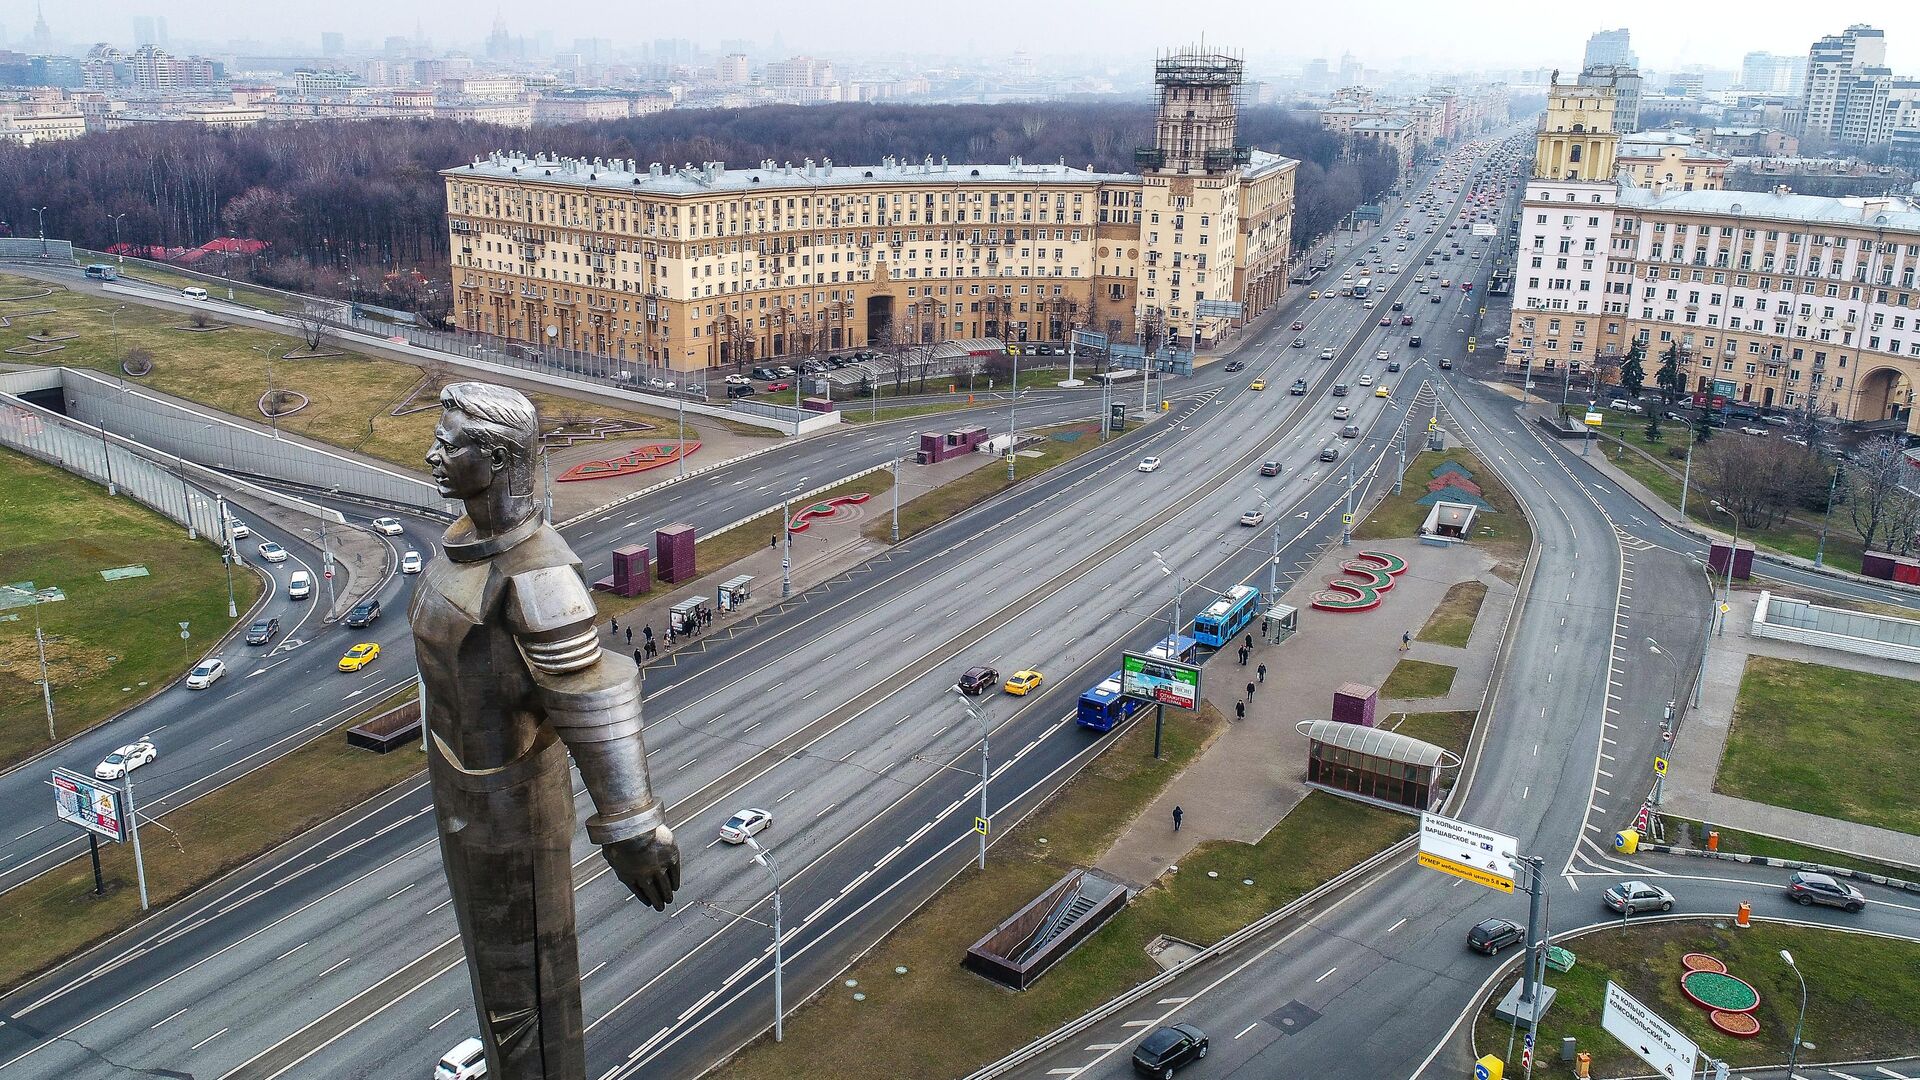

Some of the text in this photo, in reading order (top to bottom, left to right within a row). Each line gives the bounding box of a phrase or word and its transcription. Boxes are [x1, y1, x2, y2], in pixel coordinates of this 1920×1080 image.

[1425, 816, 1435, 824] 3-е
[1436, 820, 1463, 832] КОЛЬЦО
[1467, 830, 1494, 842] направо
[1425, 826, 1469, 845] ВАРШАВСКОЕ
[1420, 856, 1441, 866] РУМЕР
[1441, 863, 1473, 877] мебельный
[1473, 873, 1490, 883] центр
[1609, 999, 1663, 1043] КОМСОМОЛЬСКИЙ
[1663, 1041, 1677, 1053] пр-т
[1611, 989, 1620, 999] 3-е
[1620, 996, 1645, 1018] КОЛЬЦО
[1649, 1019, 1671, 1038] налево
